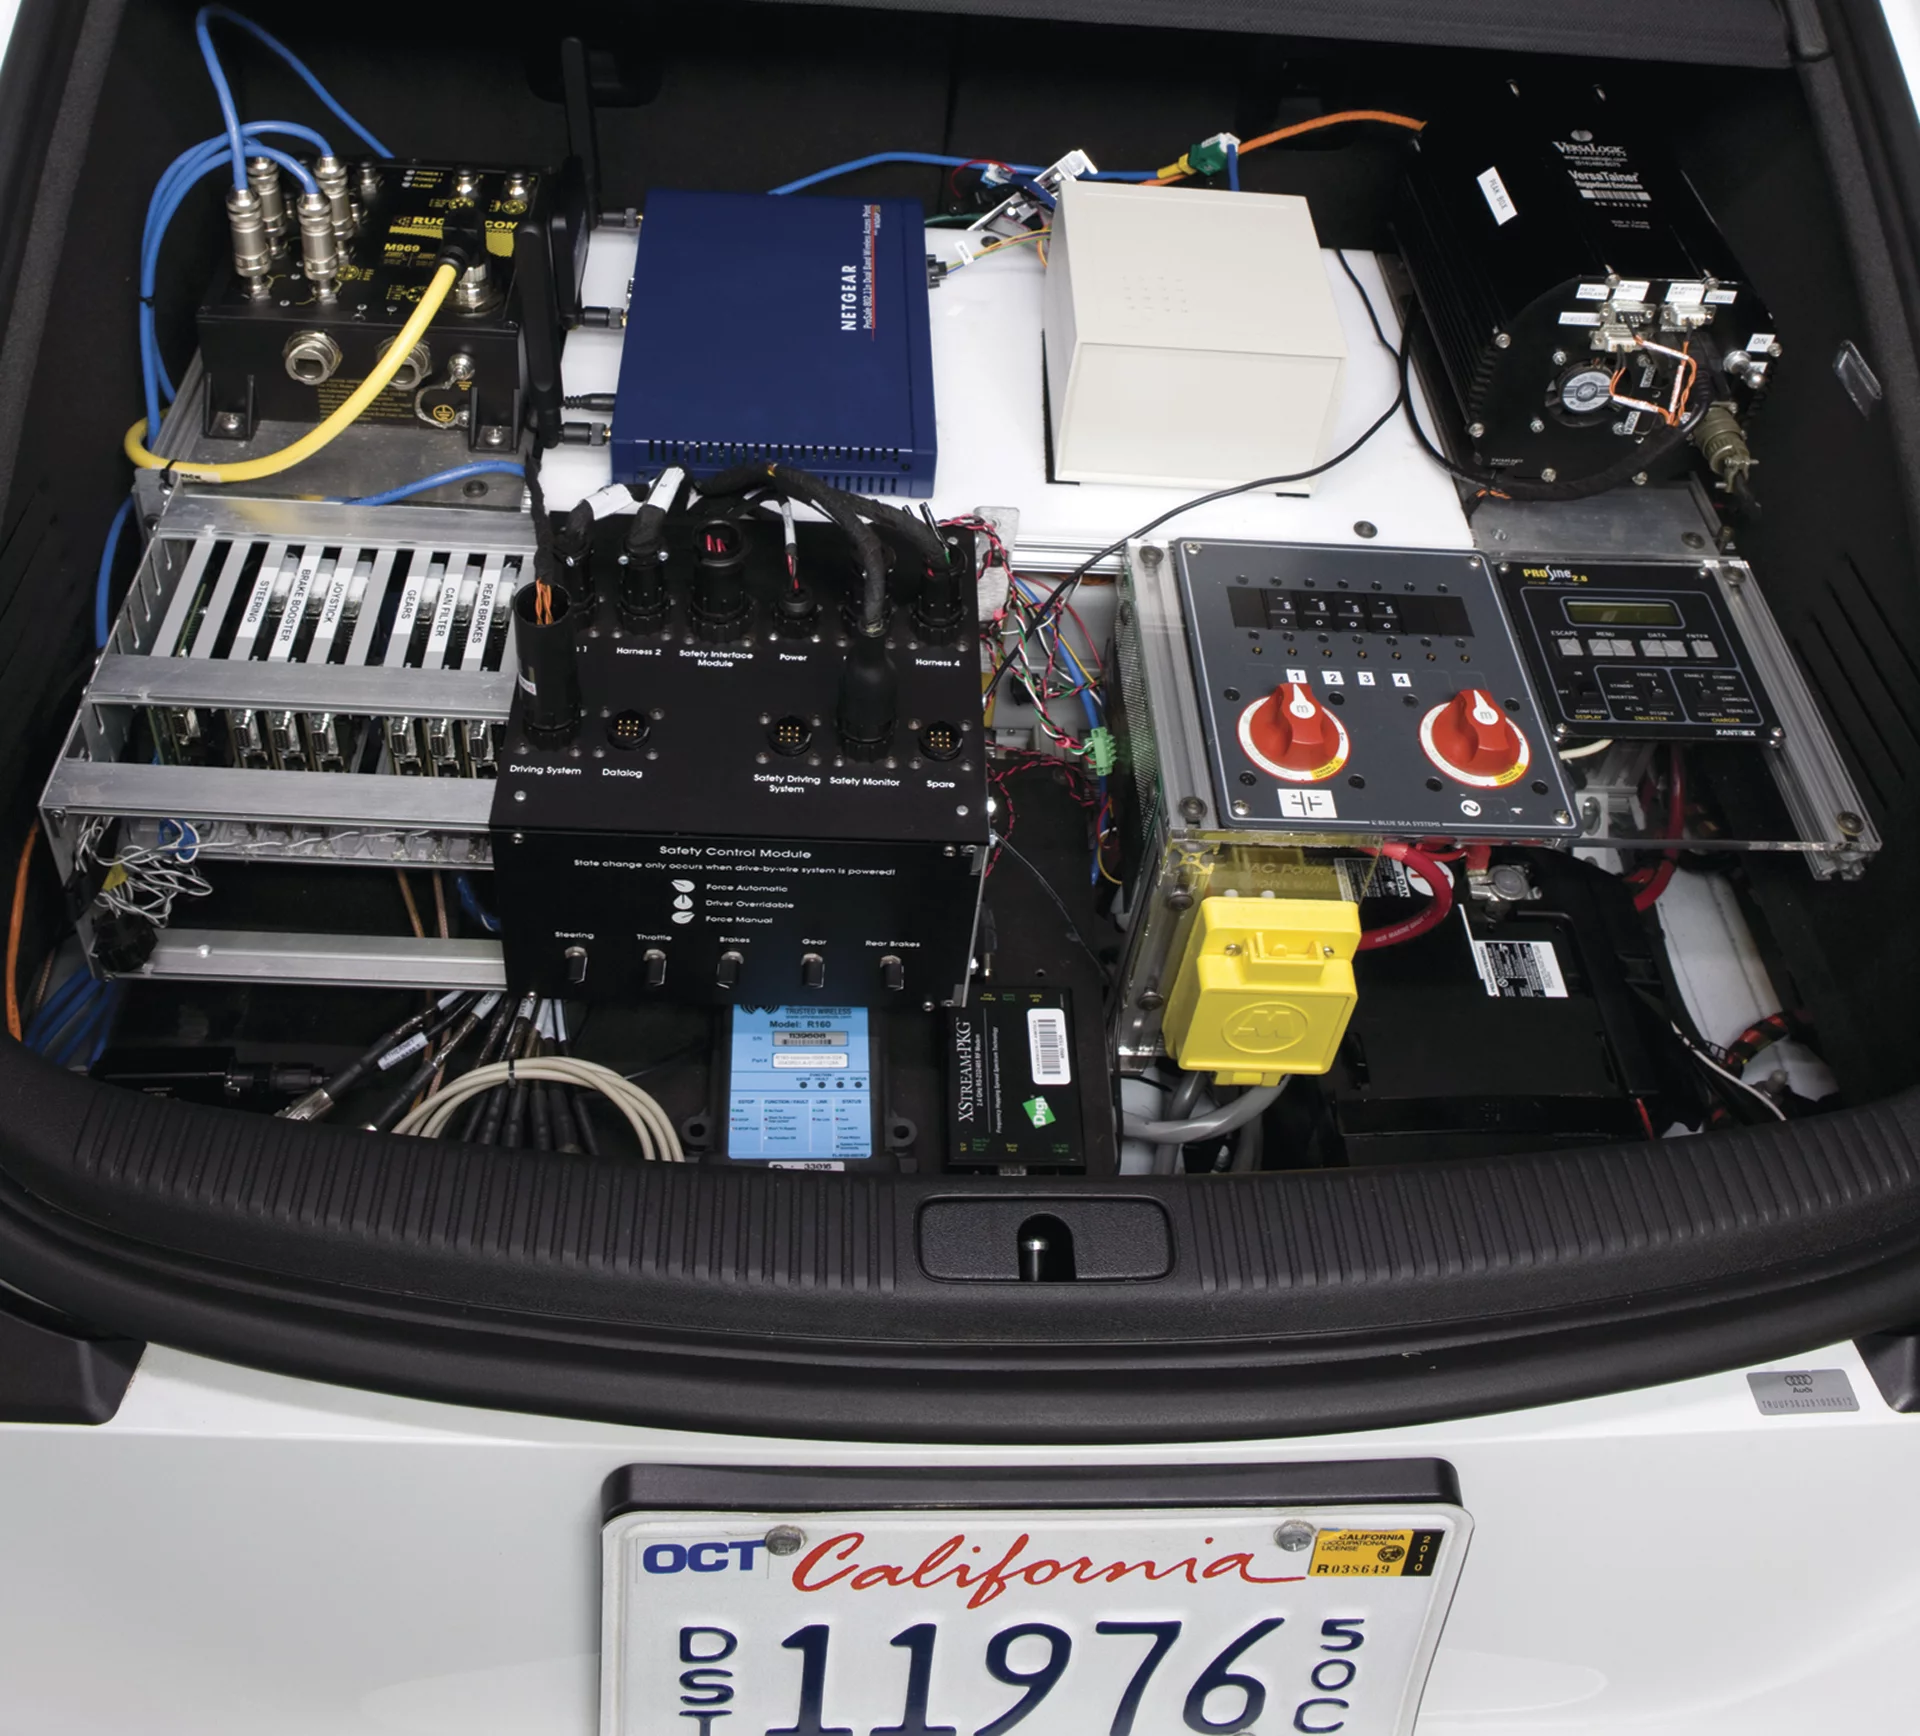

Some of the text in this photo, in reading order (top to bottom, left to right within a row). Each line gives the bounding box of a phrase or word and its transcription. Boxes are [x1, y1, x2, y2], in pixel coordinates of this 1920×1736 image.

[384, 243, 420, 253] M969
[841, 265, 857, 331] NETGEAR
[1753, 337, 1768, 345] ON
[246, 580, 270, 623] STEERING
[279, 568, 311, 642] BRAKE BOOSTER
[324, 582, 344, 623] JOYSTICK
[401, 589, 417, 620] GEARS
[435, 587, 455, 637] CAN FILTER
[472, 583, 494, 644] REAR BRAKES
[616, 647, 653, 656] Harness
[679, 650, 753, 660] Safety Interface
[779, 653, 808, 662] Power
[915, 658, 952, 667] Harness
[698, 659, 733, 668] Module
[1330, 674, 1338, 682] 2
[1363, 675, 1371, 683] 3
[1397, 676, 1405, 684] 4
[509, 765, 582, 776] Driving System
[602, 768, 643, 779] Datalog
[753, 774, 821, 785] Safety Driving
[829, 776, 901, 787] Safety Monitor
[769, 785, 804, 794] System
[926, 780, 955, 790] Spare
[659, 845, 812, 859] Safety Control Module
[574, 859, 600, 867] State
[602, 859, 642, 869] change
[645, 861, 667, 870] only
[705, 863, 732, 871] when
[735, 865, 799, 873] drive-by-wire
[801, 867, 836, 875] system
[847, 868, 896, 876] powered!
[736, 885, 788, 893] Automatic
[736, 901, 794, 909] Overridable
[554, 931, 595, 940] Steering
[636, 933, 672, 941] Throttle
[802, 938, 827, 946] Gear
[643, 1532, 1306, 1609] OCT California
[765, 1617, 1285, 1736] 11976
